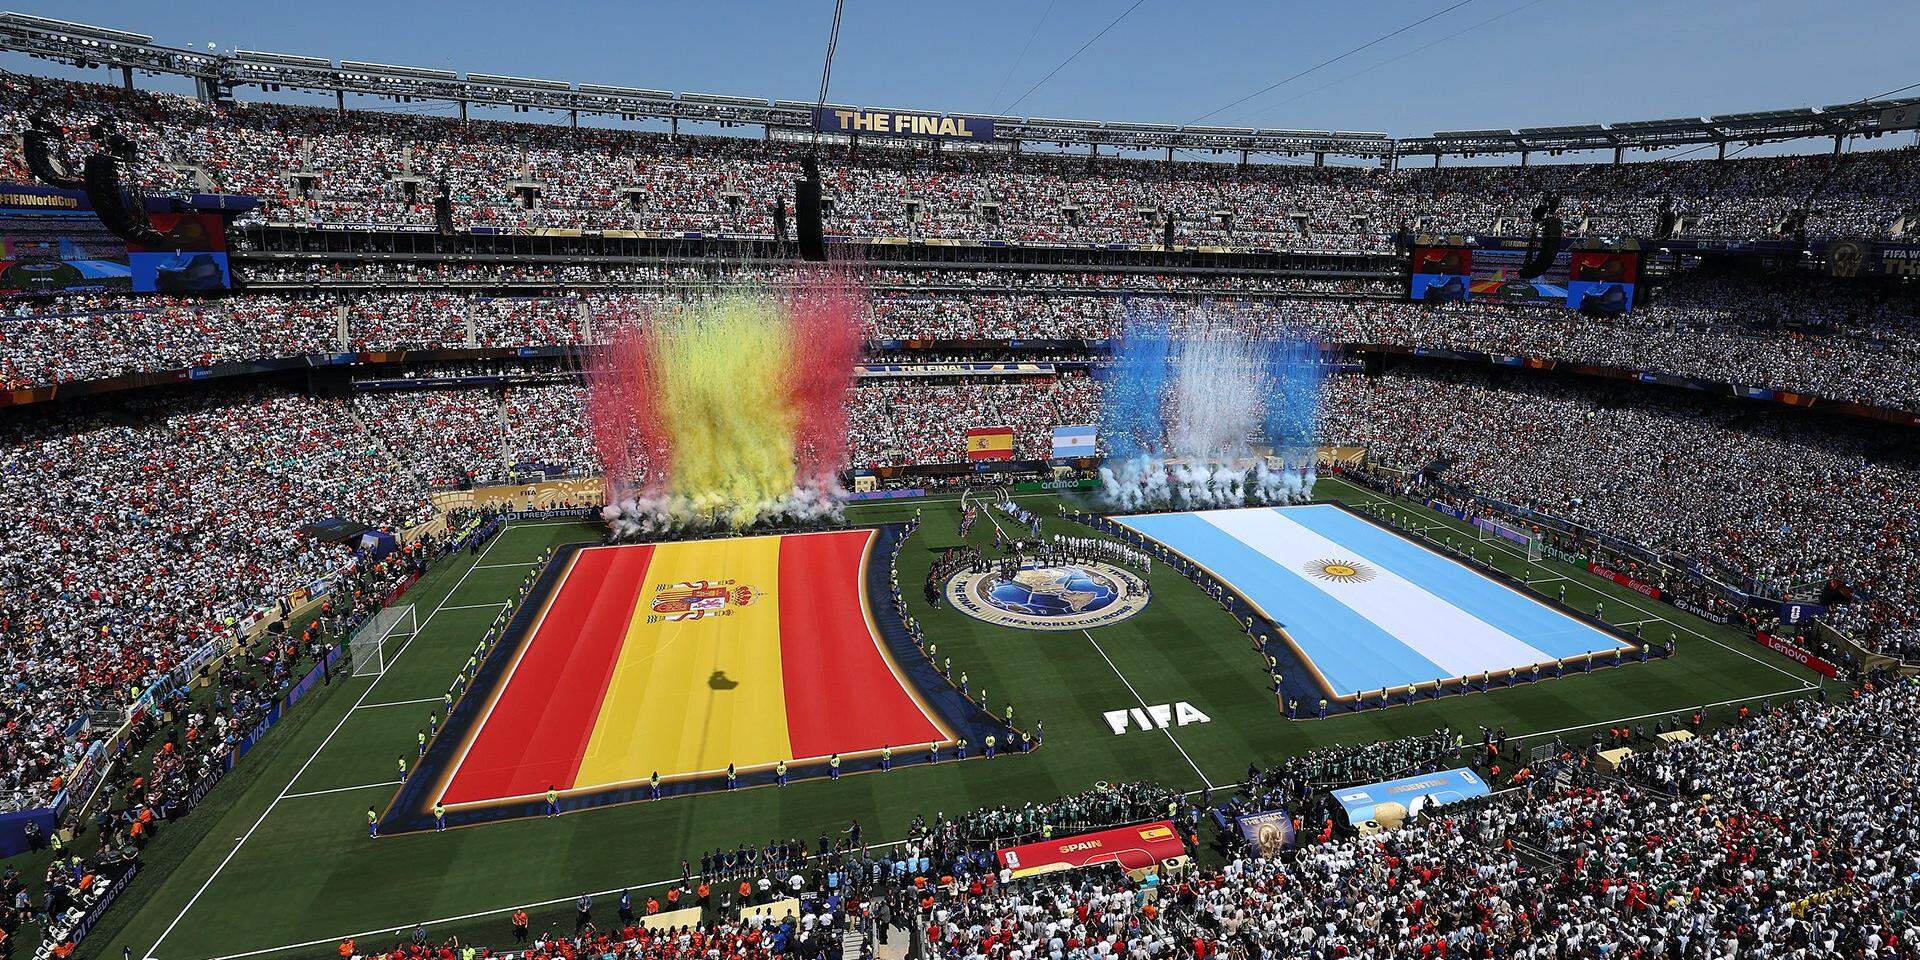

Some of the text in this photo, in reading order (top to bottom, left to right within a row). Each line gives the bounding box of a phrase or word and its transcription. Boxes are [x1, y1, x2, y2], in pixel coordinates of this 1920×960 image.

[835, 111, 973, 137] THE FINAL
[1883, 249, 1907, 259] FIFA
[901, 364, 925, 372] THE
[1042, 479, 1079, 490] aramco
[1441, 505, 1457, 517] VISA
[1537, 543, 1576, 564] aramco
[955, 581, 981, 613] THE FINAL
[1000, 616, 1028, 625] FIFA
[1077, 617, 1101, 626] CUP
[1101, 605, 1133, 620] 2026
[1768, 638, 1808, 664] Lenovo
[1103, 701, 1211, 736] FIFA
[249, 721, 271, 745] VISA
[187, 768, 224, 811] AIRWAYS
[1058, 839, 1104, 854] SPAIN
[73, 924, 87, 945] DI
